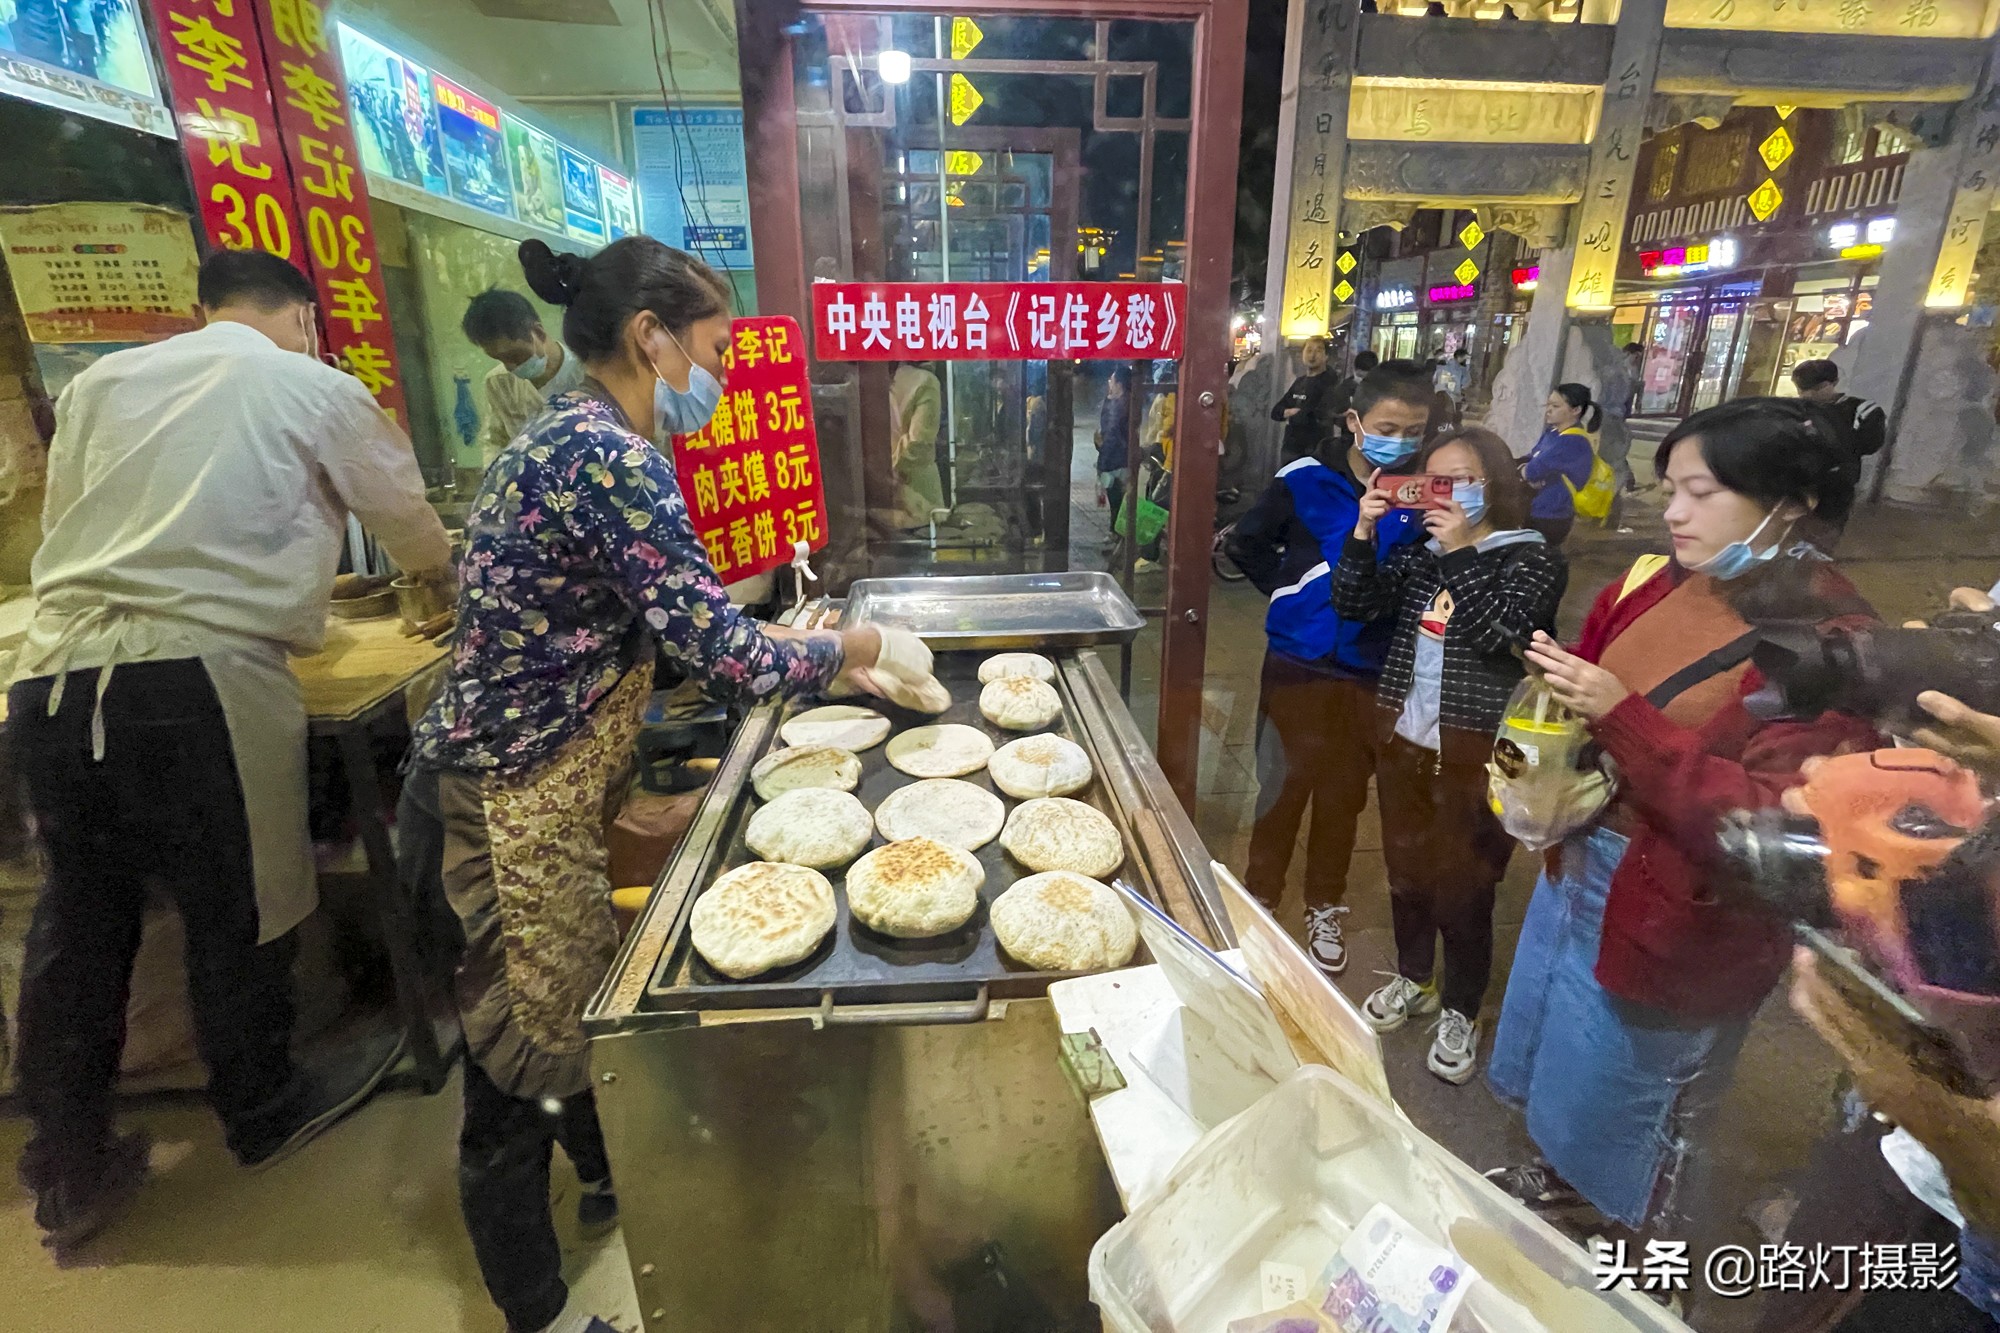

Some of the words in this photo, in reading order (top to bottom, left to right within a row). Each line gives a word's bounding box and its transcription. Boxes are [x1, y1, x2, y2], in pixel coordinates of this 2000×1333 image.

[168, 0, 291, 260] 李记30
[827, 291, 1177, 351] 中央电视台《记住乡愁》
[765, 386, 804, 434] 3元
[692, 450, 770, 518] 肉夹馍
[775, 444, 813, 491] 8元
[703, 508, 777, 575] 五香饼
[782, 500, 820, 545] 3元
